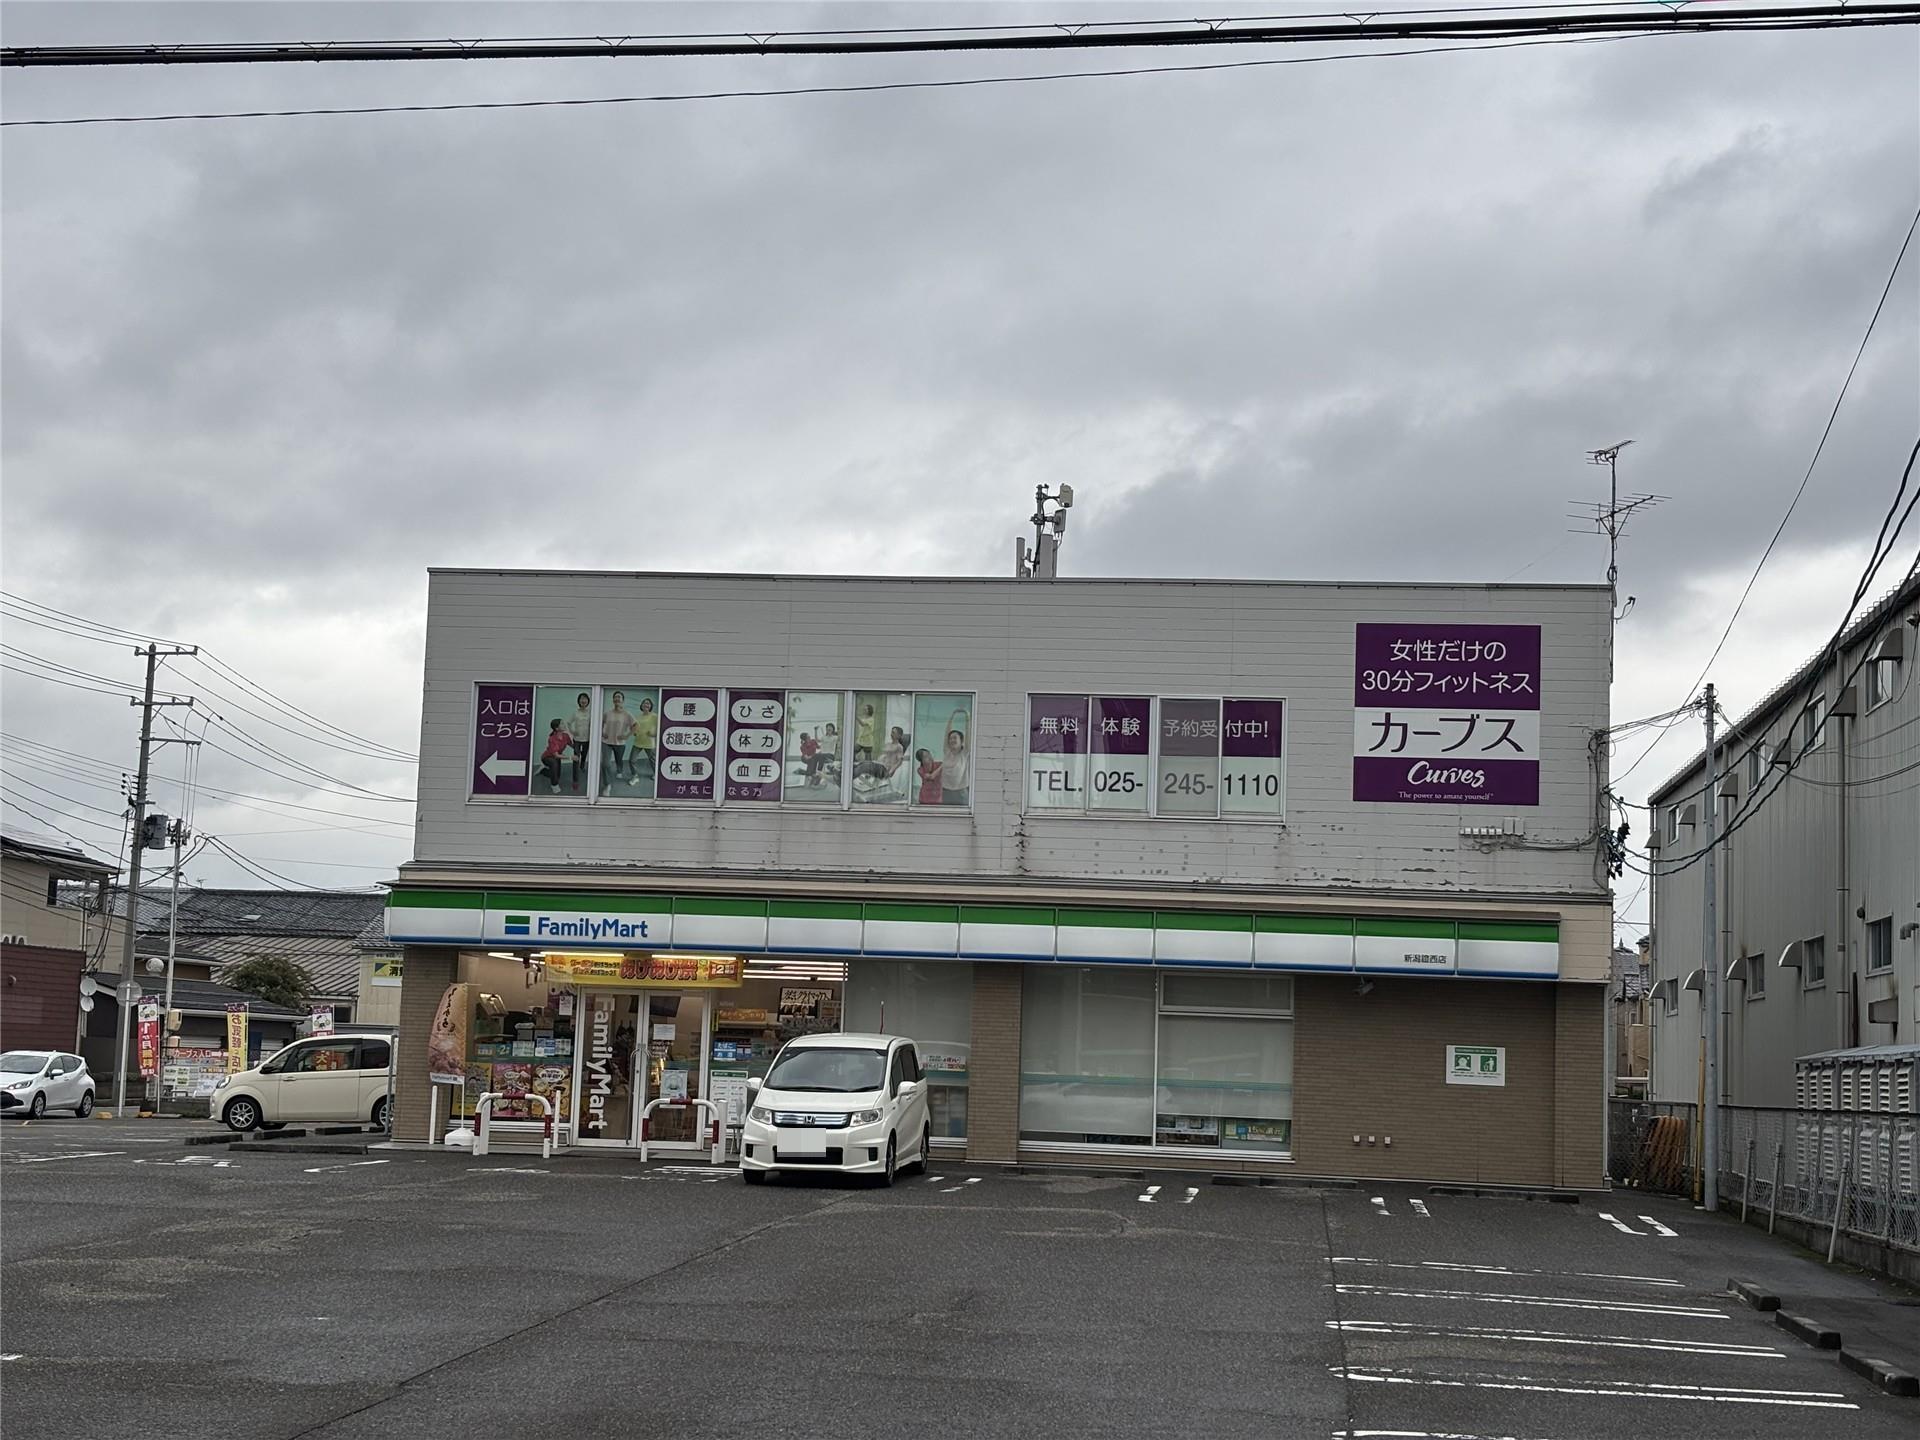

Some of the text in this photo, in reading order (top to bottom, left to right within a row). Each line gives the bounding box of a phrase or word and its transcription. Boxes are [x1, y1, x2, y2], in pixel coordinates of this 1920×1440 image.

[1390, 639, 1507, 662] 女性だけの
[1362, 670, 1534, 694] 30分フィットネス
[480, 698, 530, 716] 入口は
[682, 701, 697, 718] 腰
[740, 704, 775, 719] ひざ
[479, 720, 529, 739] こちら
[1039, 716, 1268, 738] 無料 体験 予約受付中!
[1368, 712, 1525, 753] カーブス
[664, 730, 711, 748] お腹たるみ
[739, 733, 774, 749] 体力
[668, 760, 705, 778] 体重
[736, 763, 773, 780] 血圧
[1407, 761, 1486, 788] Curves
[676, 784, 764, 798] が気になる方
[1033, 770, 1279, 796] TEL. 025- 245- 1110
[1413, 793, 1433, 801] power
[538, 917, 649, 939] FamilyMart
[586, 993, 615, 1129] FamilyMart
